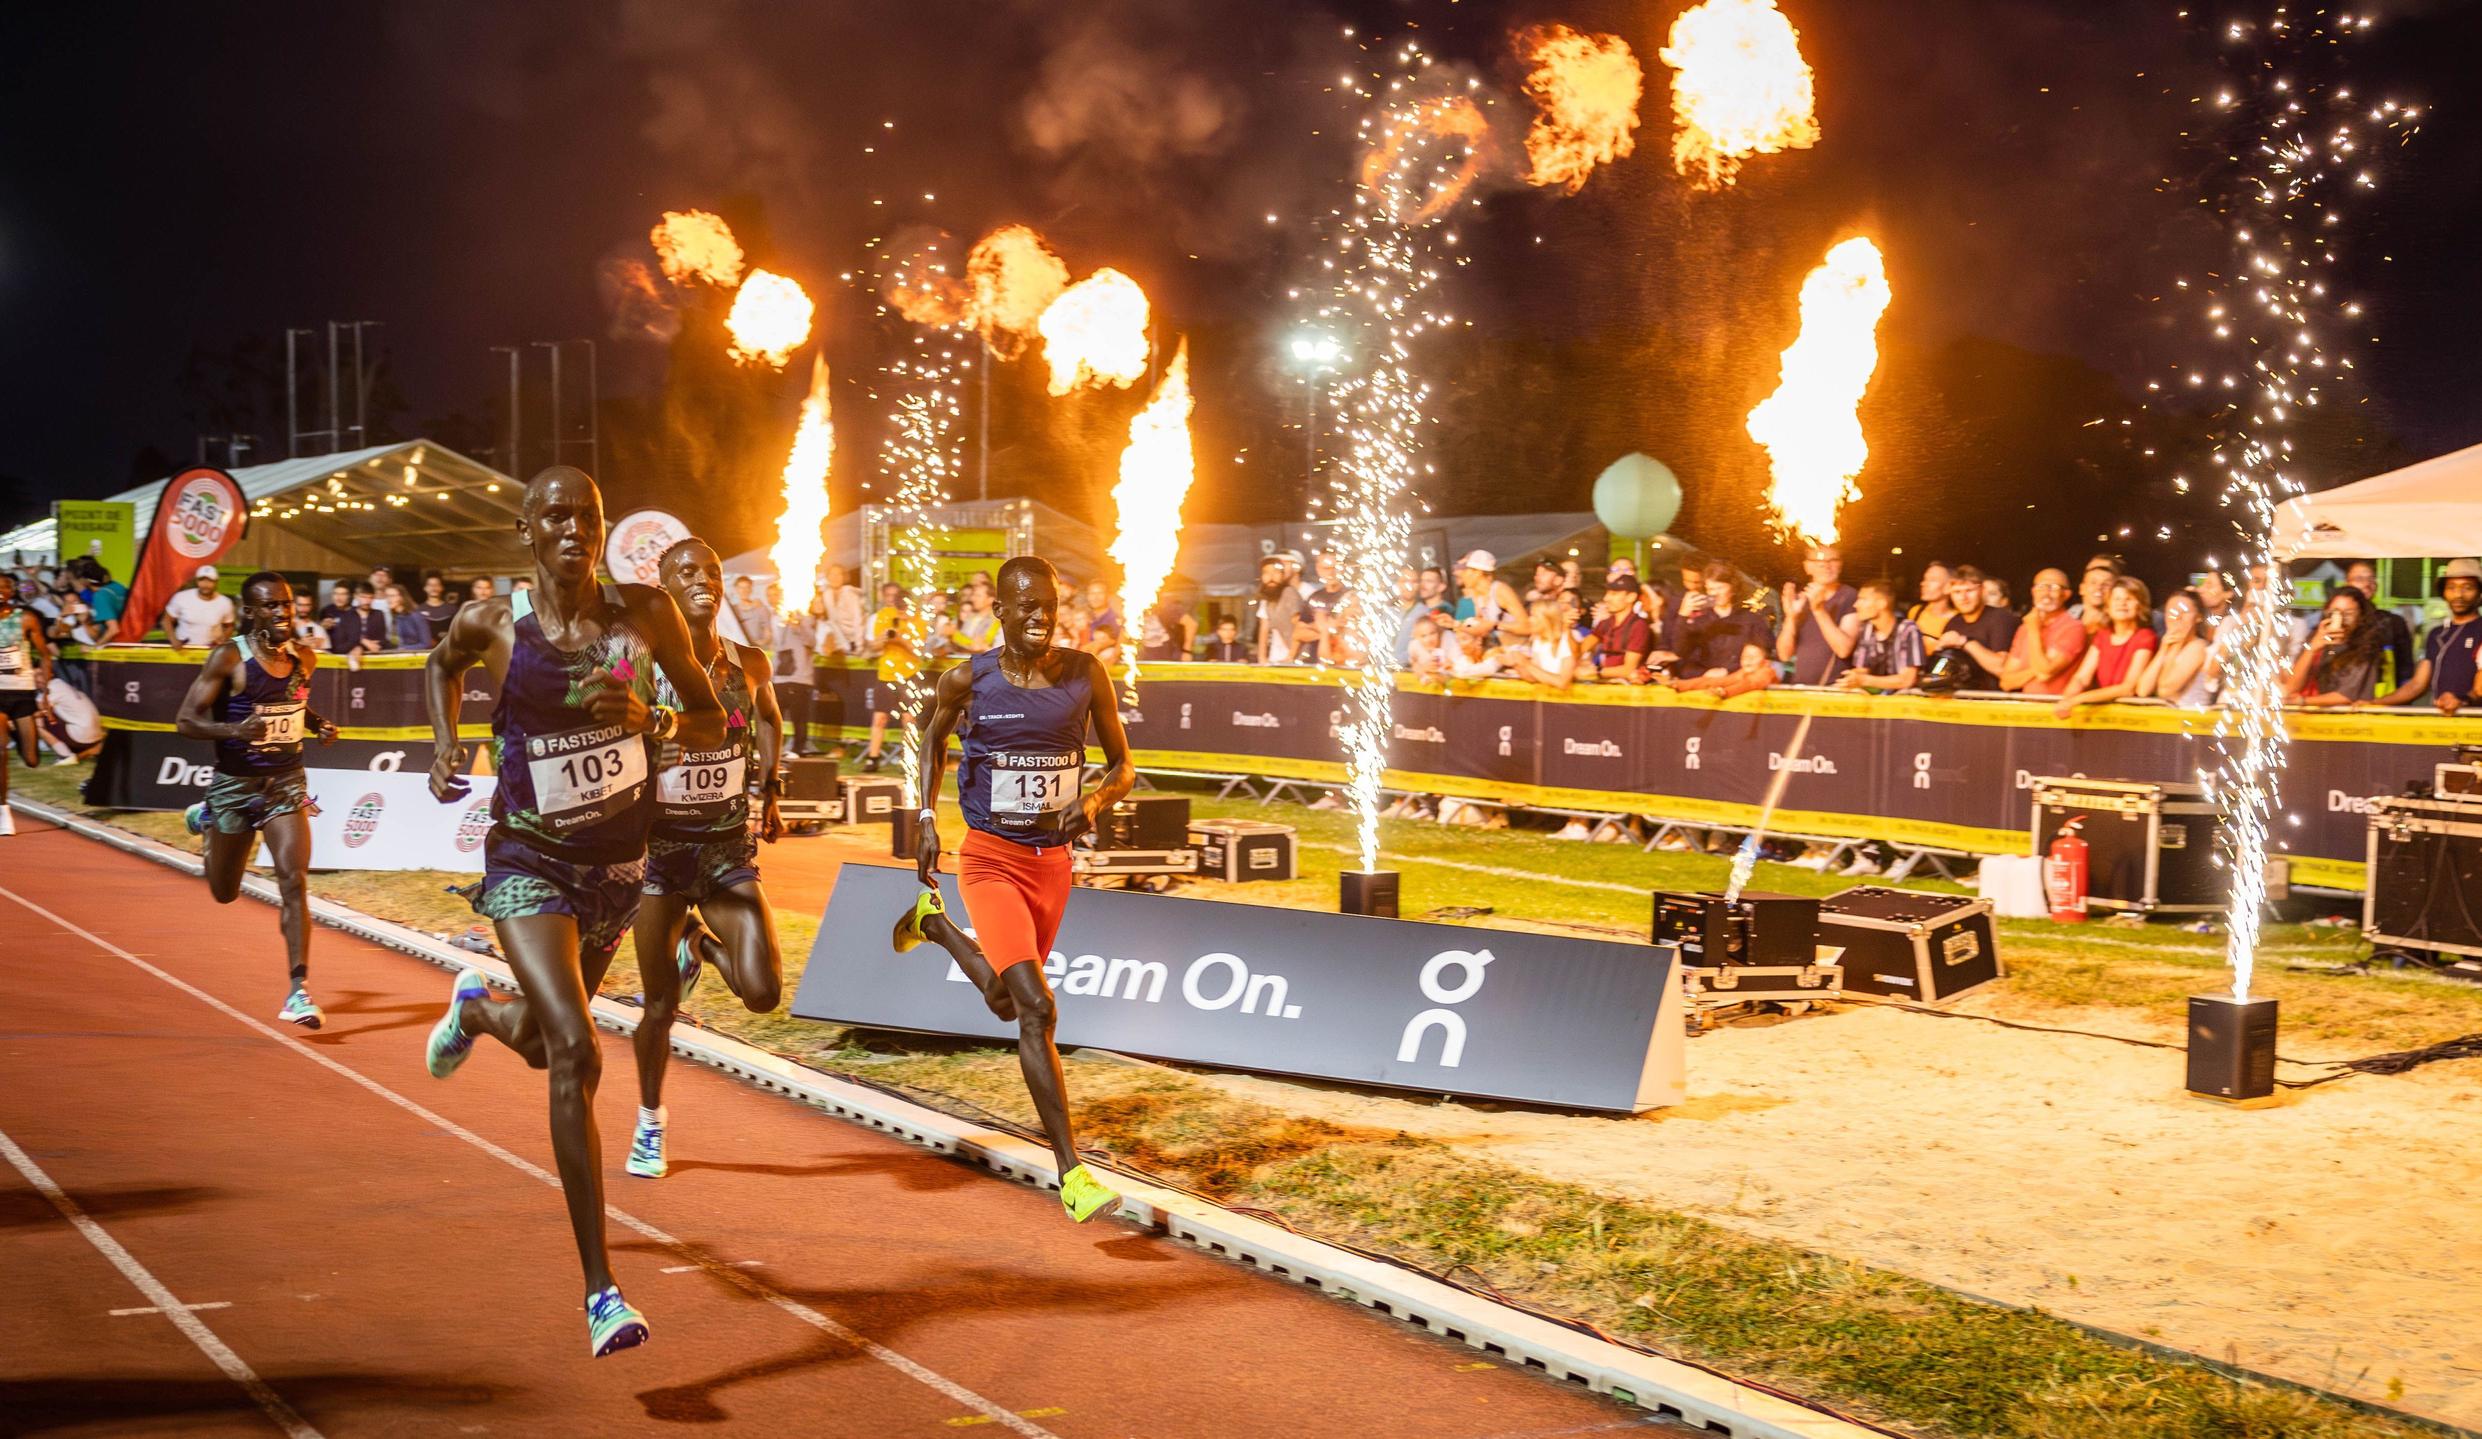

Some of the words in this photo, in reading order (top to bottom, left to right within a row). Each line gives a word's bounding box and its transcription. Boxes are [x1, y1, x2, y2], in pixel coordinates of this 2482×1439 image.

[178, 492, 225, 525] FAST
[170, 507, 221, 542] 5000
[547, 725, 622, 752] FAST5000
[1564, 738, 1600, 755] Dream
[1600, 740, 1622, 757] On.
[683, 749, 731, 763] AST5000
[1009, 756, 1068, 767] FAST5000
[1812, 755, 1837, 774] On.
[157, 756, 214, 787] Dre
[561, 749, 623, 788] 103
[680, 767, 728, 791] 109
[1015, 774, 1061, 799] 131
[581, 784, 613, 802] KIBET
[682, 792, 724, 802] KWIZERA
[665, 808, 688, 816] Dream
[1022, 802, 1053, 811] ISMAIL
[463, 812, 490, 824] FAS
[555, 814, 585, 828] Dream
[585, 810, 602, 821] On.
[1001, 818, 1024, 827] Dream
[946, 928, 1168, 1002] eam
[1182, 952, 1303, 1019] On.
